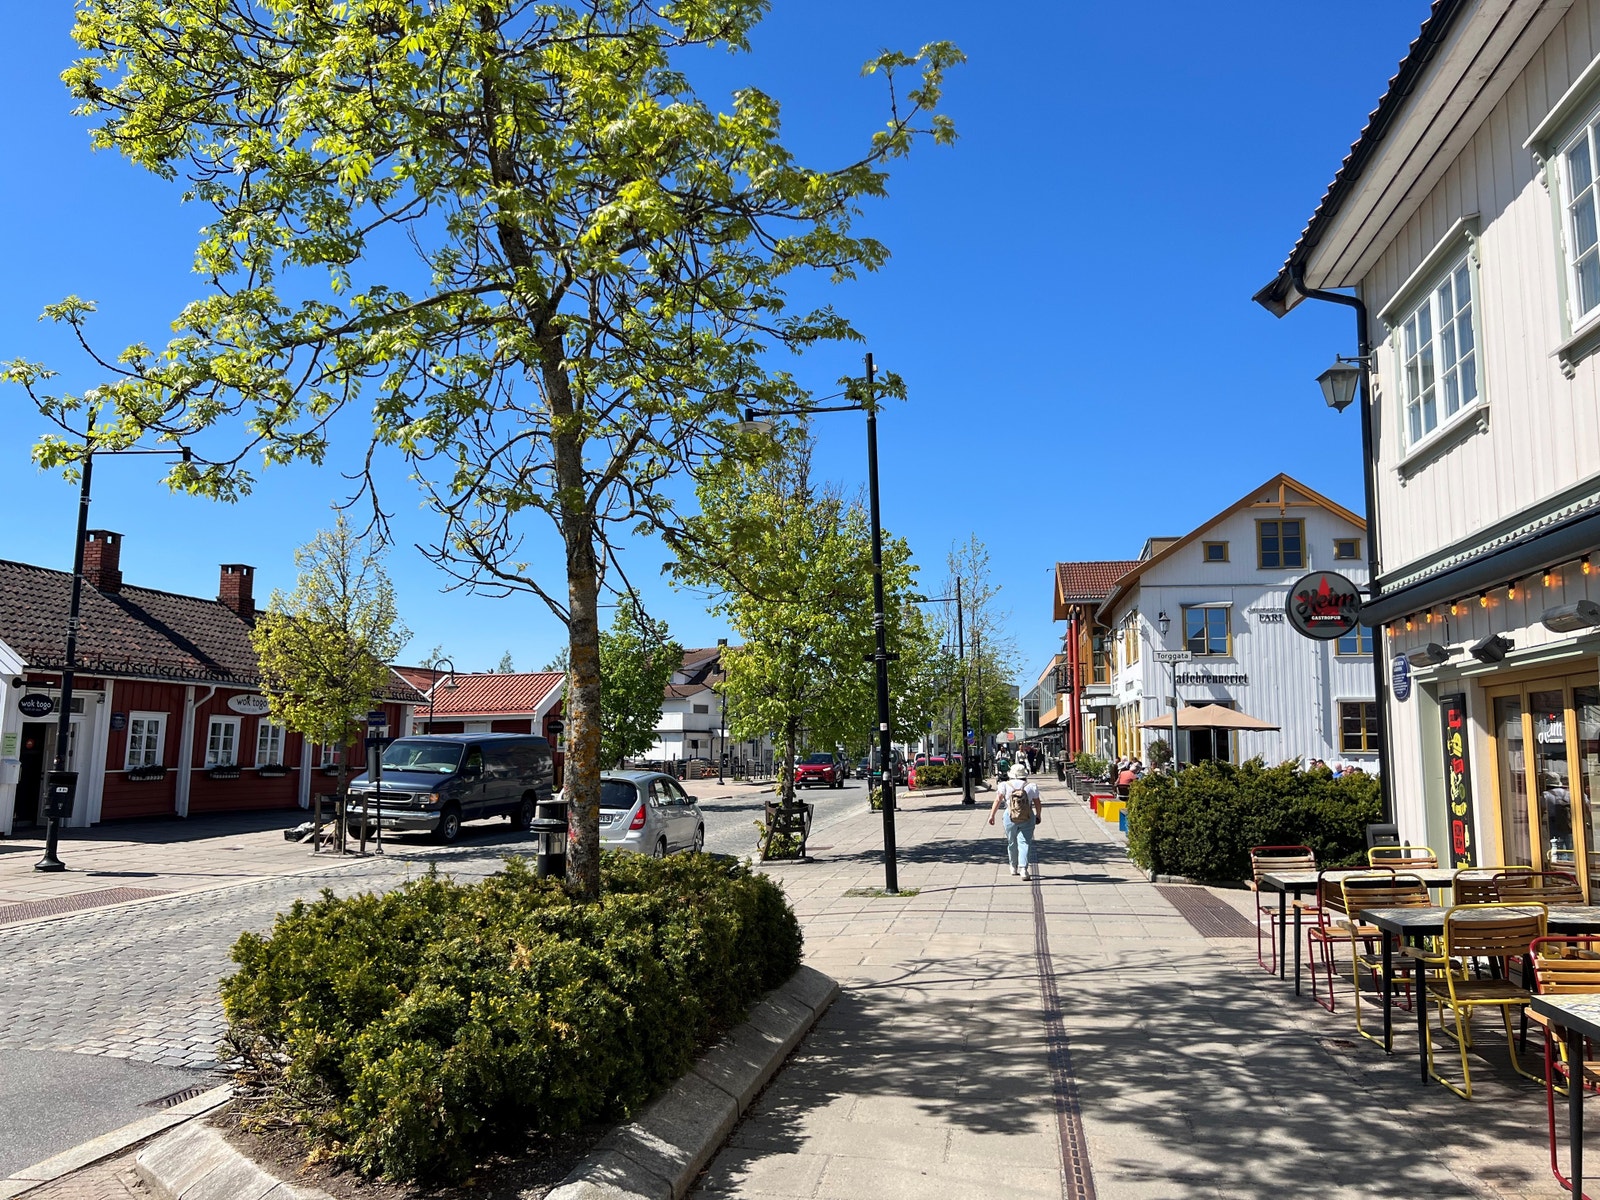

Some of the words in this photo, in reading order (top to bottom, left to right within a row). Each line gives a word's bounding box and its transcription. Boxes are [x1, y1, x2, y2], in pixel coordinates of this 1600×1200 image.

[1296, 587, 1356, 614] Heim
[1157, 652, 1189, 660] Torggata
[1169, 671, 1249, 684] affebrenneriet
[21, 699, 35, 707] wok
[36, 700, 52, 710] togo
[237, 697, 251, 706] wok
